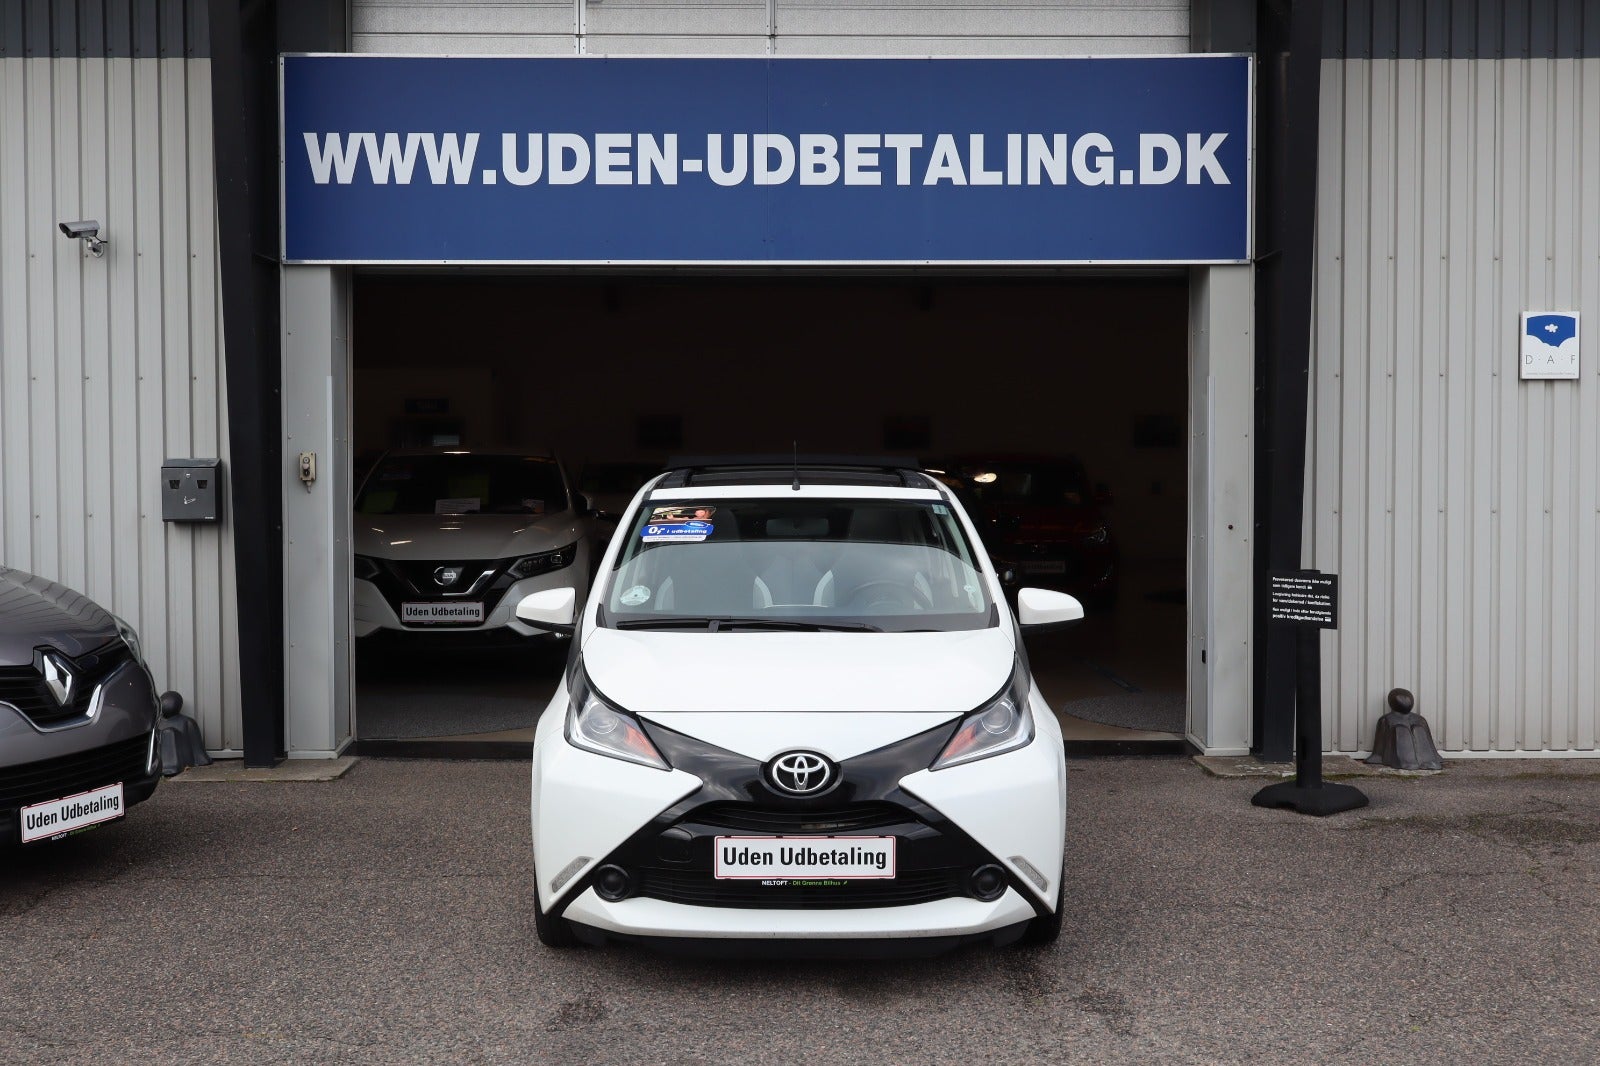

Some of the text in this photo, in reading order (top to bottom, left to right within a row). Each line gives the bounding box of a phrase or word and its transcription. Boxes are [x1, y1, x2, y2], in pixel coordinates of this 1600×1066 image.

[303, 132, 1231, 186] WWW.UDEN-UDBETALING.DK
[406, 606, 480, 618] Uden Udbetaling
[26, 795, 119, 830] Uden Udbetaling
[723, 846, 887, 870] Uden Udbetaling
